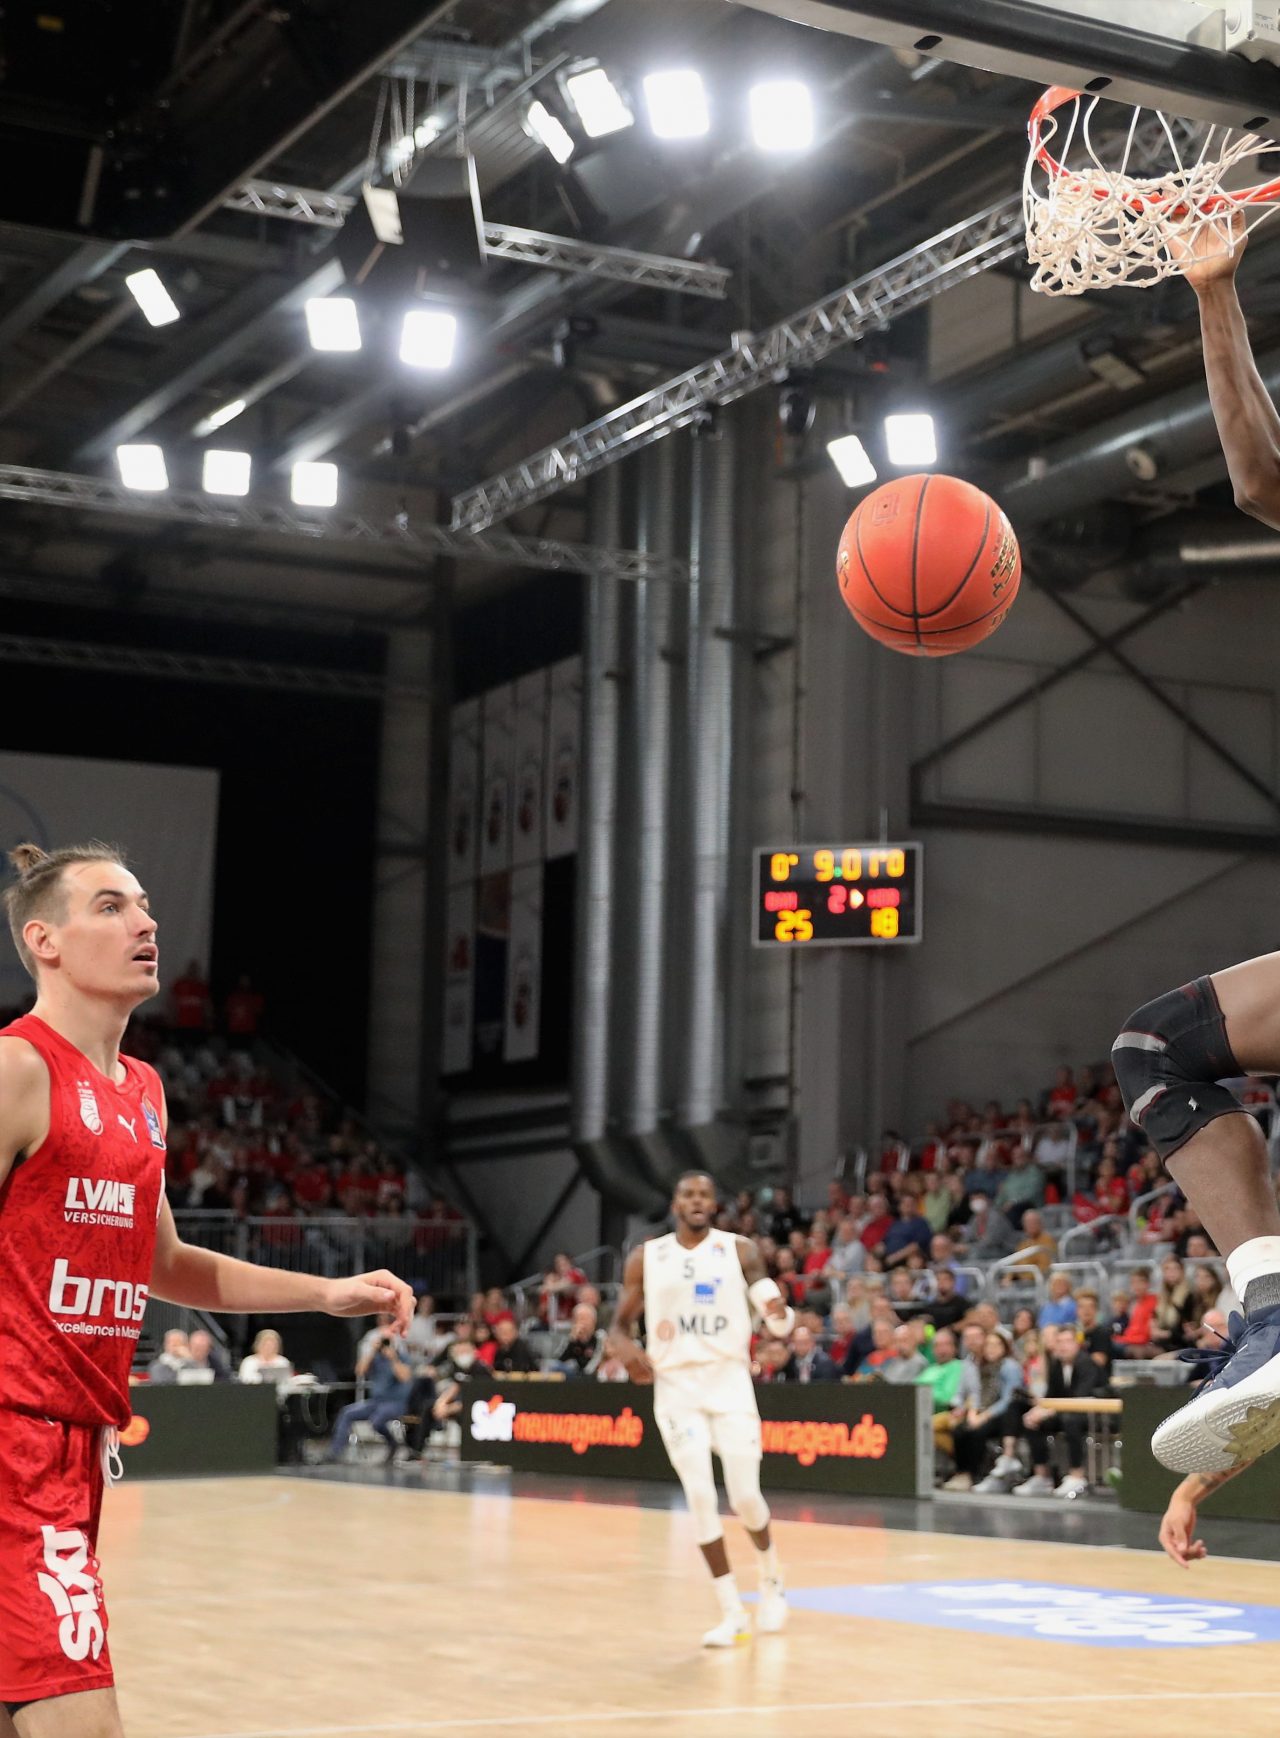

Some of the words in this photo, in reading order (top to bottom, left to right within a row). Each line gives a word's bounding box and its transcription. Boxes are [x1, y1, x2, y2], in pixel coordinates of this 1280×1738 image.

[828, 884, 847, 914] 2
[775, 909, 813, 942] 25
[65, 1177, 121, 1215] LVM
[63, 1211, 134, 1229] VERSICHERUNG
[48, 1258, 149, 1321] bros
[52, 1319, 114, 1337] xcellence
[679, 1315, 728, 1336] MLP
